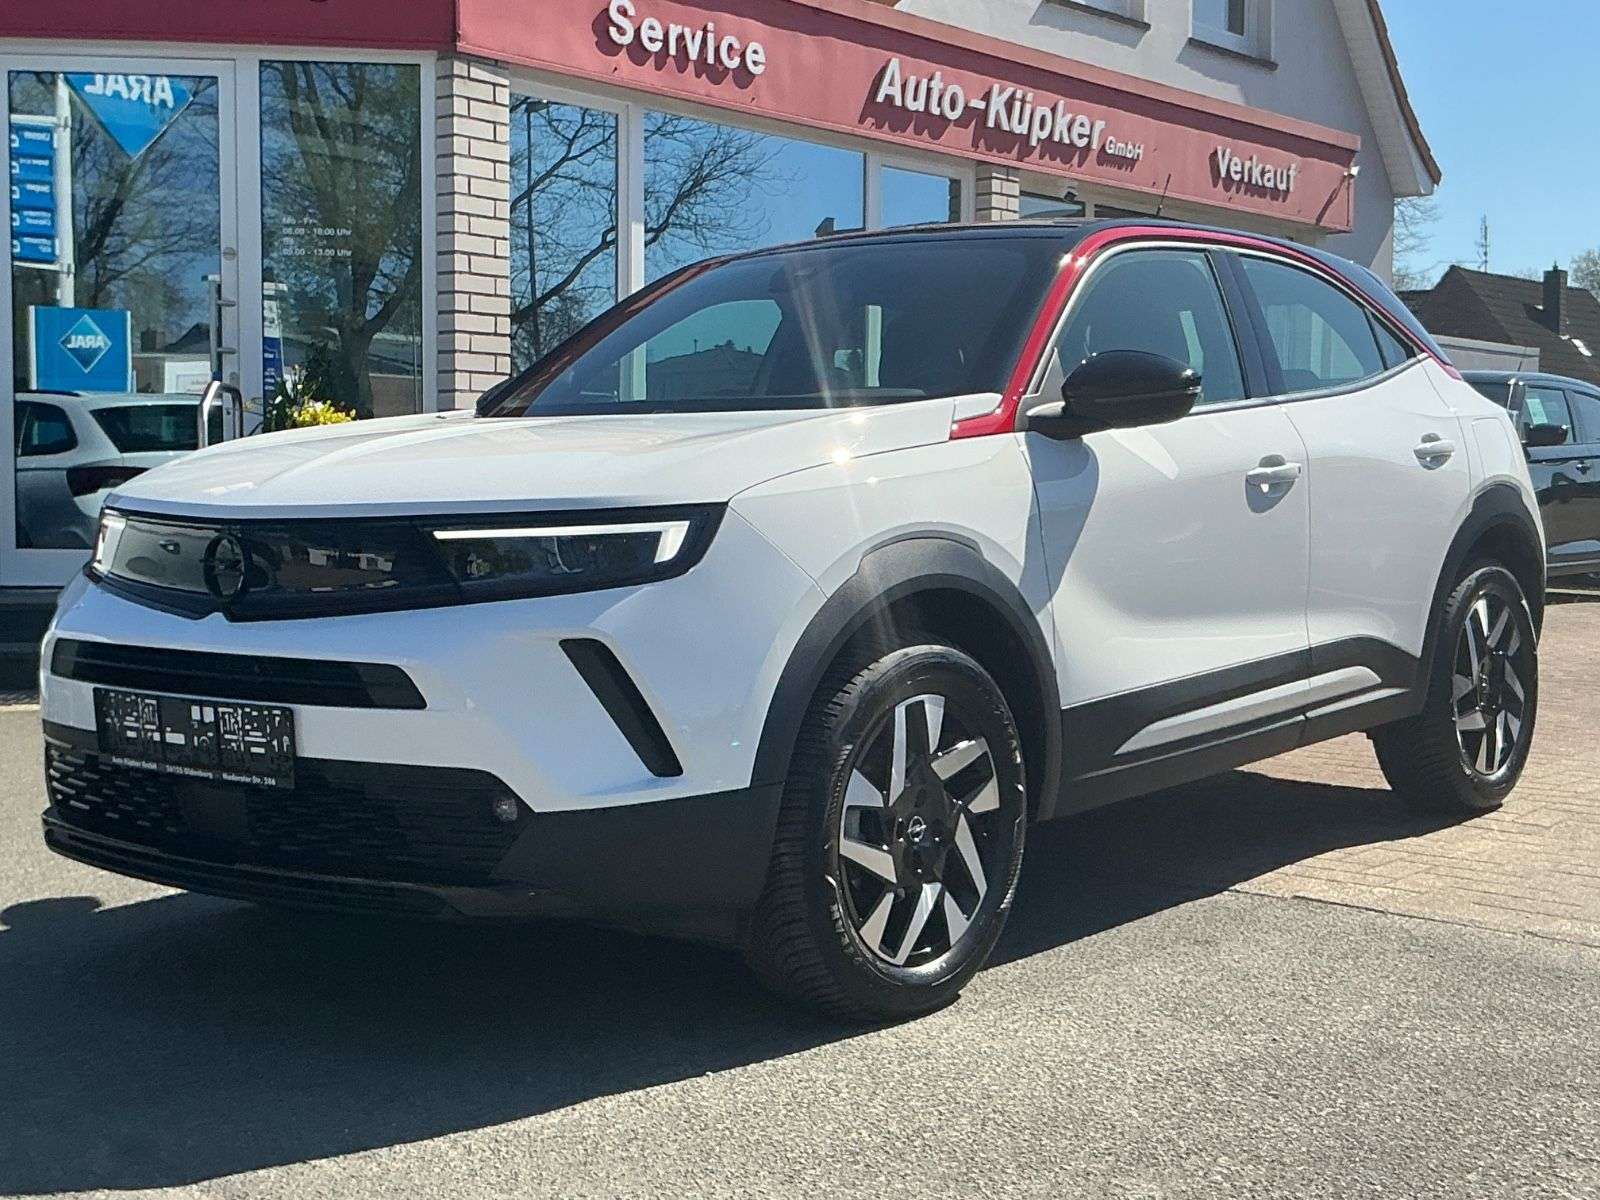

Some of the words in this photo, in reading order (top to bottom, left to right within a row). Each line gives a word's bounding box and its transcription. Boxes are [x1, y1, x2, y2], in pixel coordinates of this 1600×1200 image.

[608, 0, 766, 75] Service
[876, 57, 1106, 150] Auto-Küpker
[1104, 136, 1143, 160] GmbH
[1216, 145, 1297, 192] Verkauf
